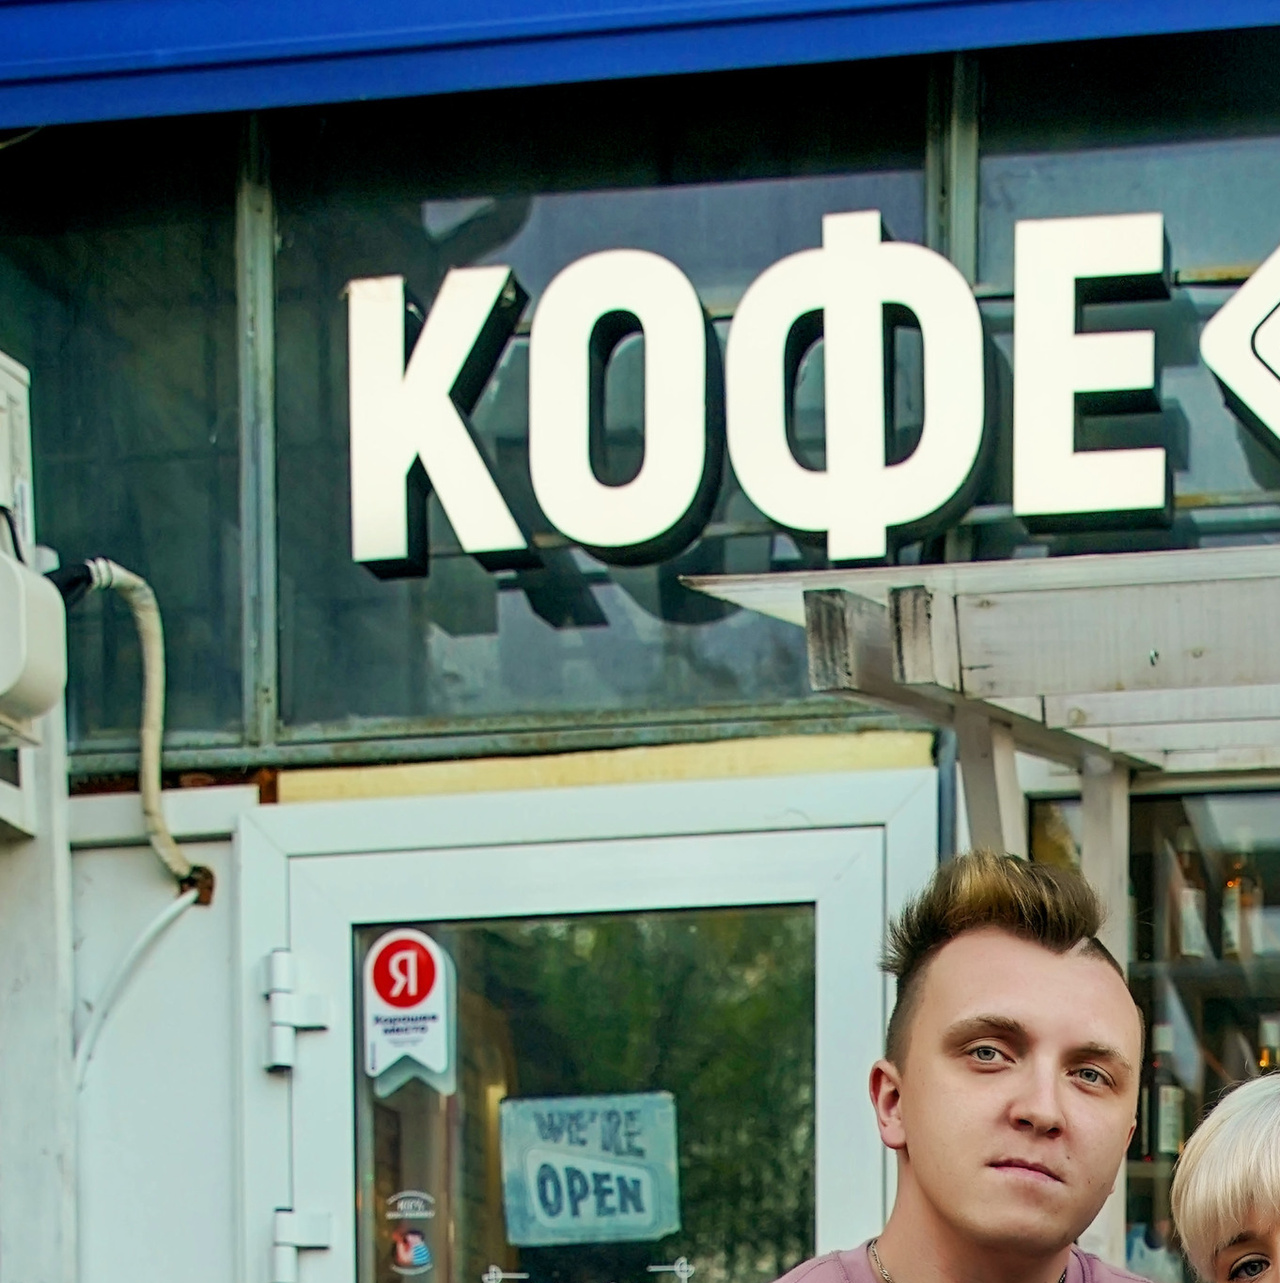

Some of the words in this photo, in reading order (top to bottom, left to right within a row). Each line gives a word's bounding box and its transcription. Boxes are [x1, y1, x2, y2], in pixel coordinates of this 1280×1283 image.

[347, 208, 1168, 564] КОФЕ
[387, 949, 419, 998] Я
[533, 1108, 646, 1158] WE'RE
[536, 1163, 645, 1218] OPEN
